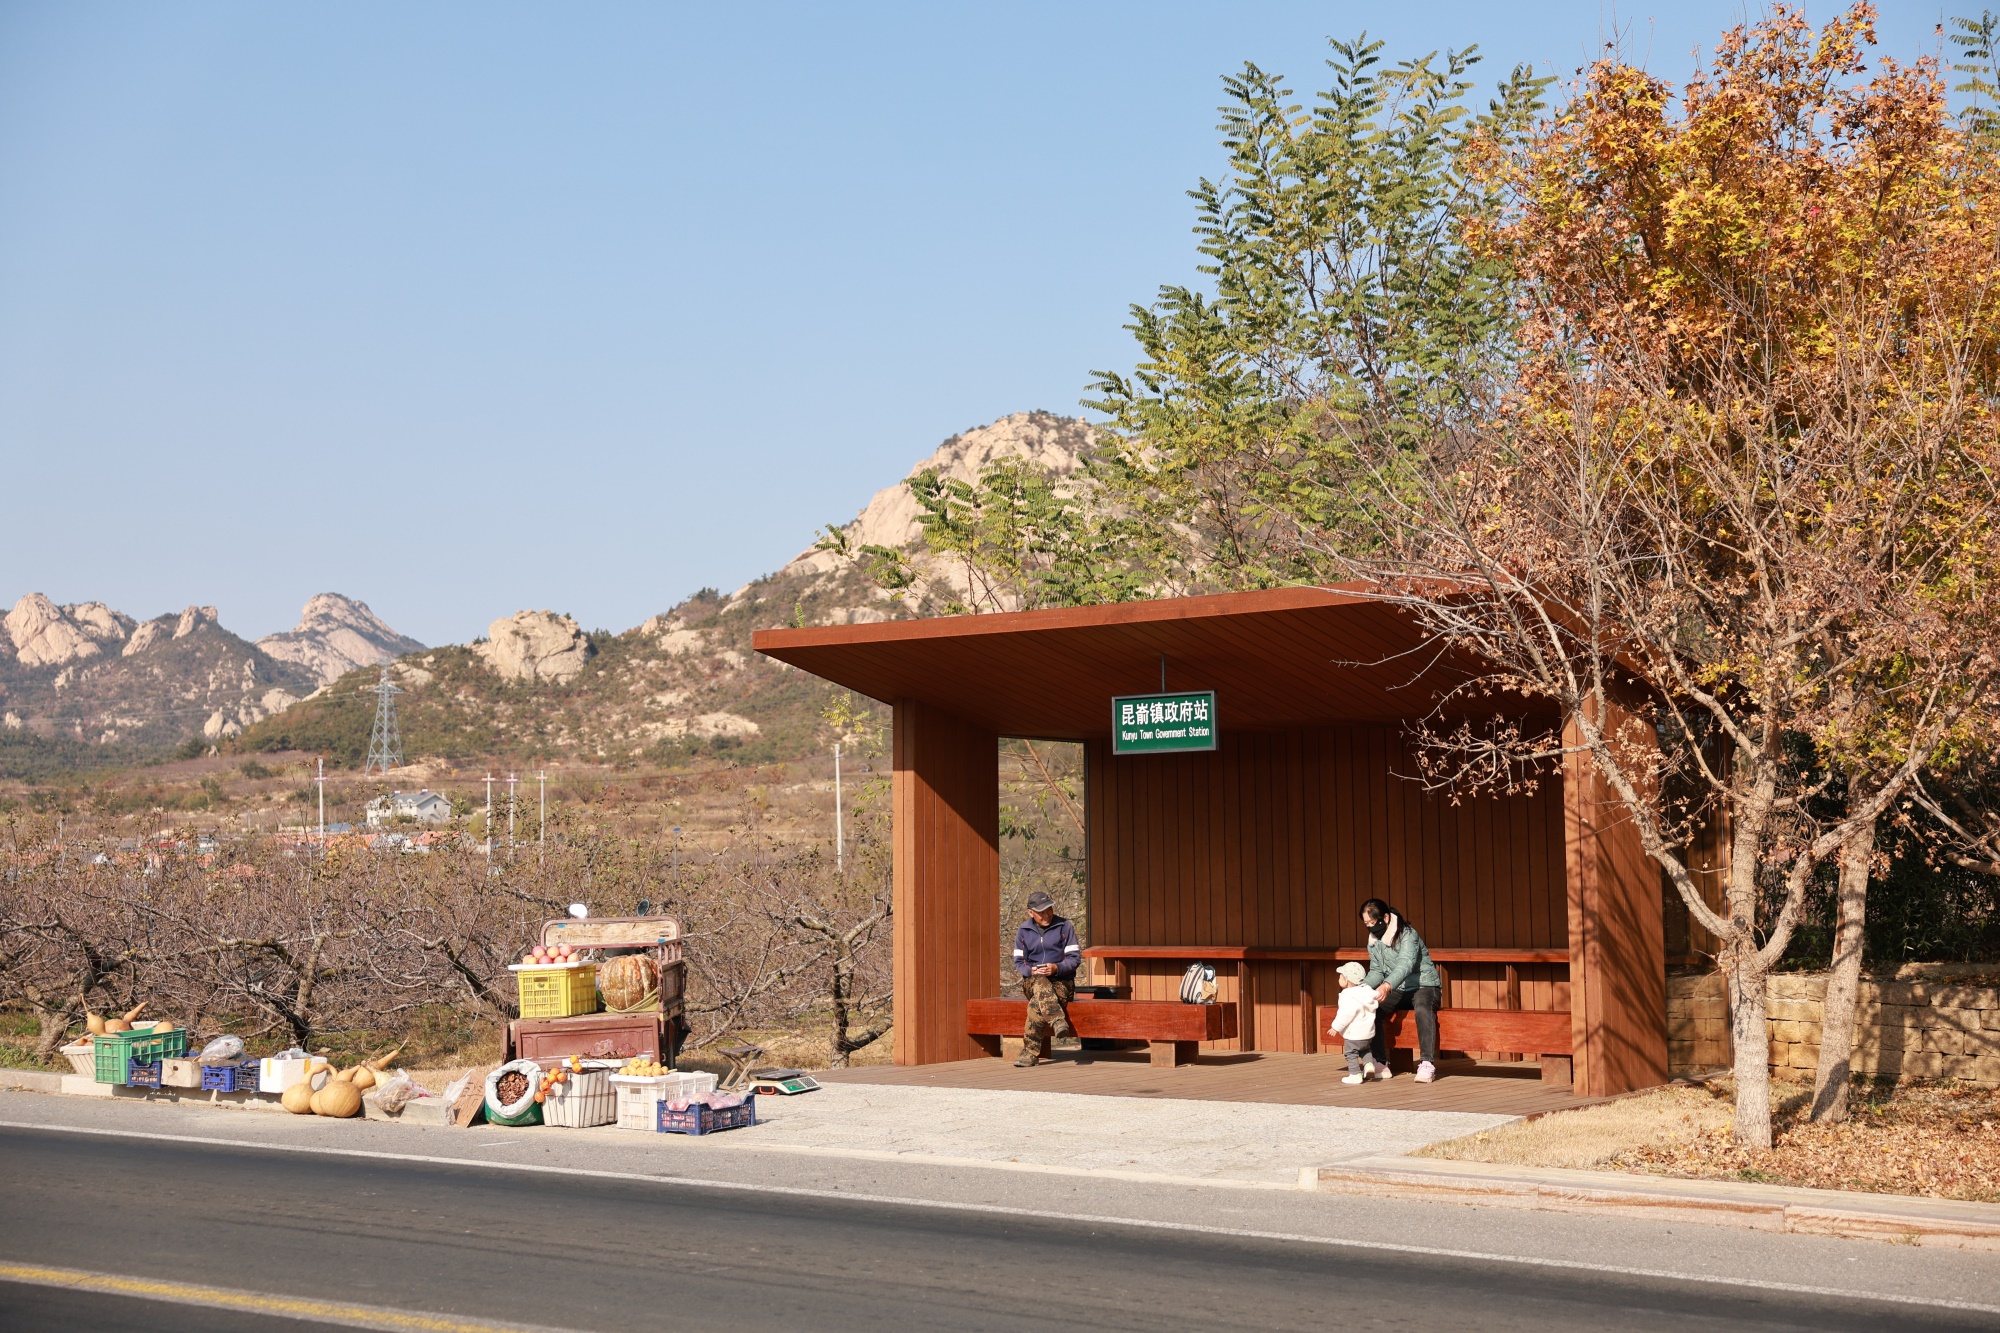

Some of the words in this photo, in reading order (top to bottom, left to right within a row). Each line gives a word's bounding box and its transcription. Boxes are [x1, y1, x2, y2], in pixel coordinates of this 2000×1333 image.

[1121, 699, 1209, 726] 昆嵛镇政府站
[1122, 730, 1138, 742] Kunyu
[1139, 729, 1154, 740] Town
[1155, 727, 1187, 739] Government
[1188, 726, 1209, 737] Station
